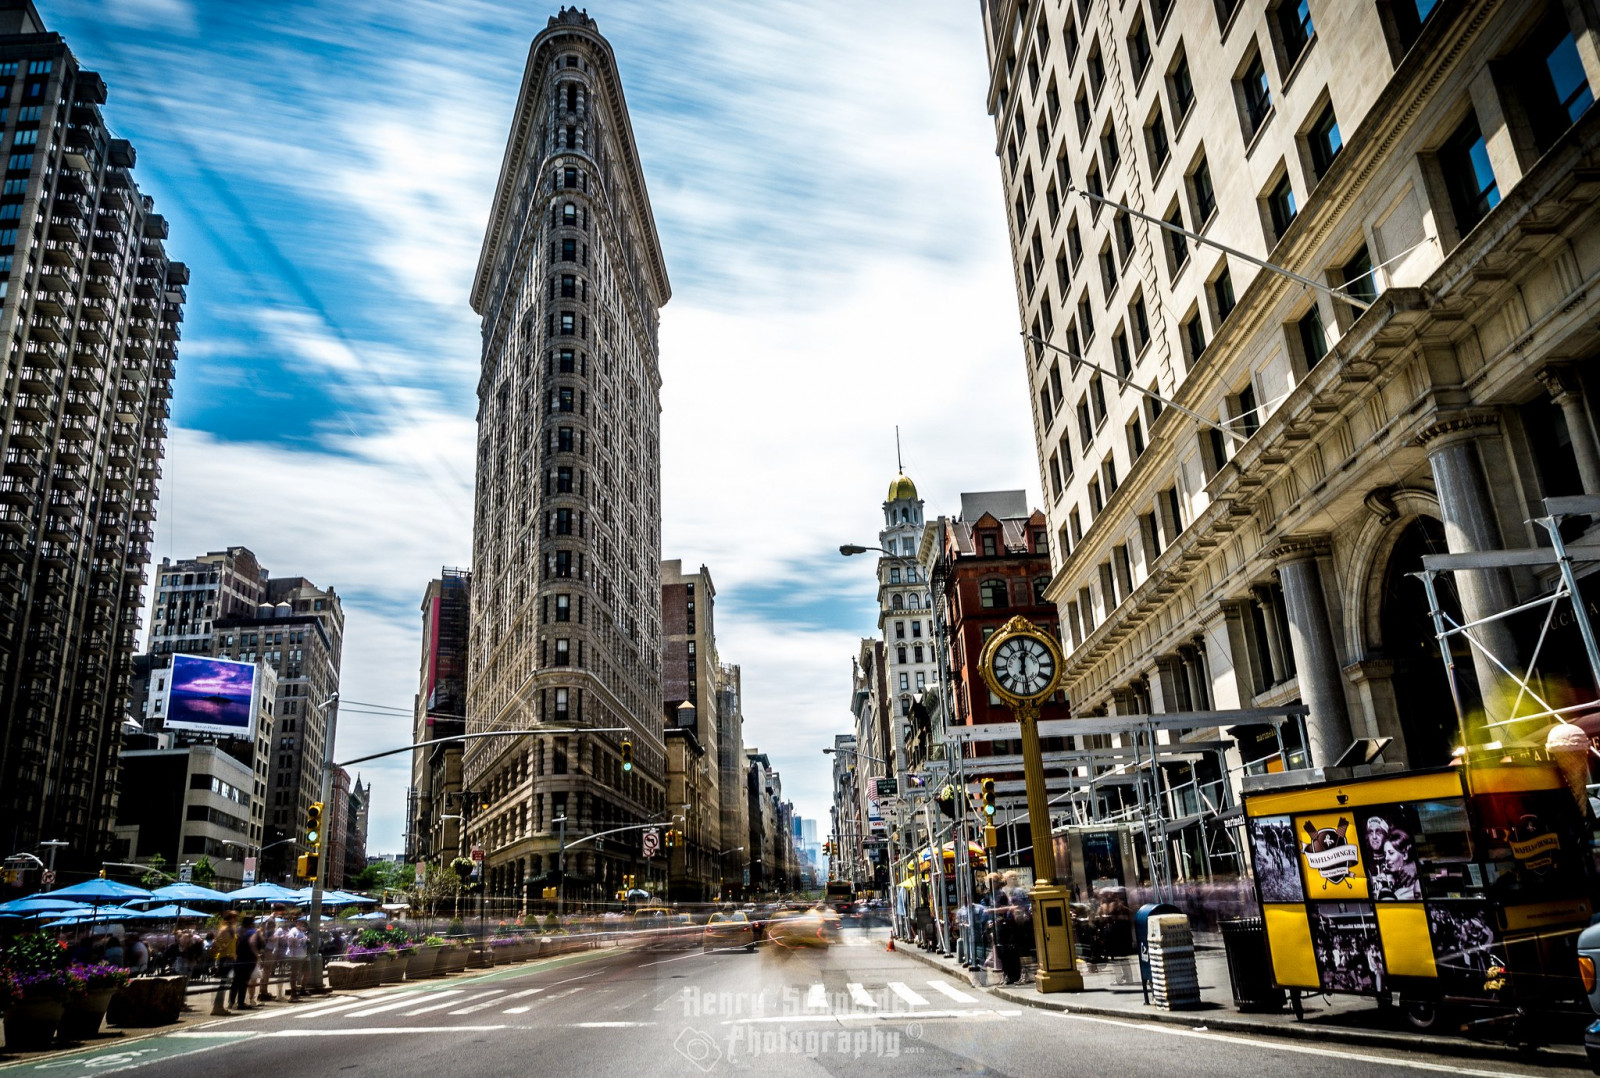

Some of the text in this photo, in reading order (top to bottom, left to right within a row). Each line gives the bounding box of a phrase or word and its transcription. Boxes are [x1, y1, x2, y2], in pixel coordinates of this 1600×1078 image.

[1539, 601, 1598, 632] CUCIA
[1008, 654, 1018, 668] FIFTH
[1012, 671, 1037, 682] BUILING
[1309, 854, 1331, 865] WAFELS
[1333, 849, 1356, 859] DINGES
